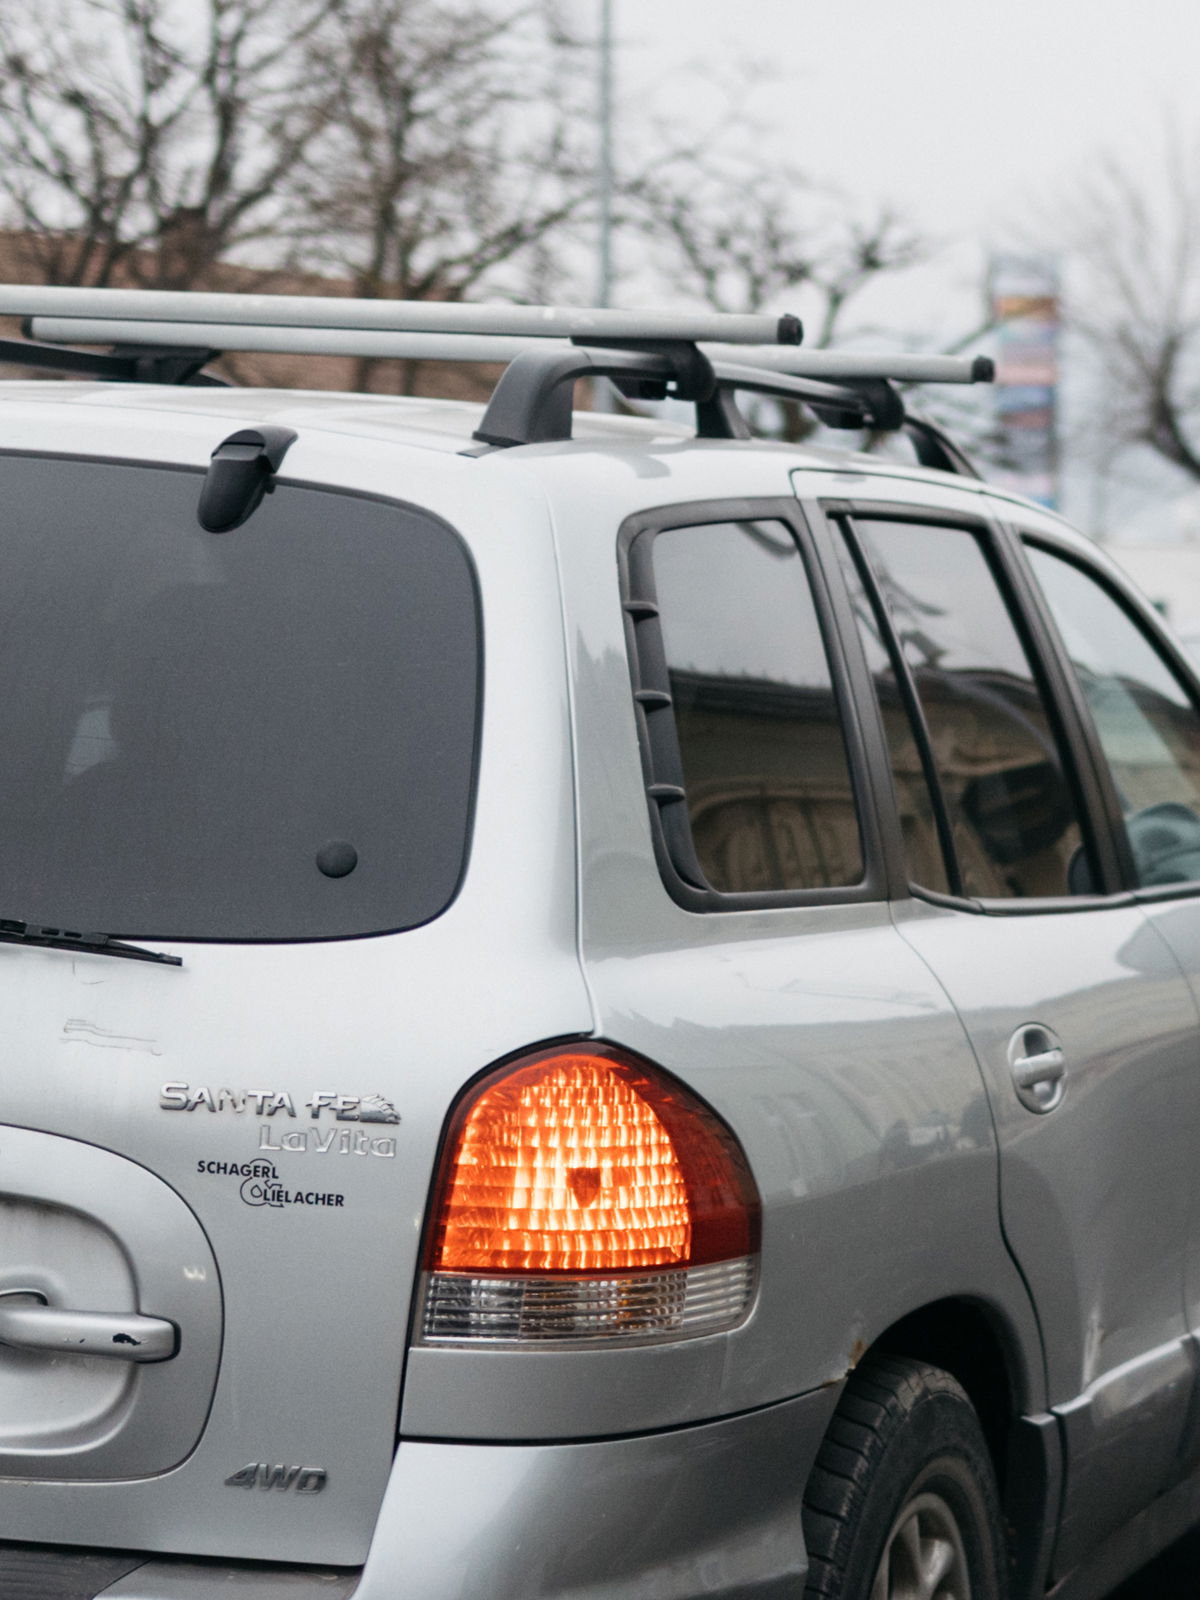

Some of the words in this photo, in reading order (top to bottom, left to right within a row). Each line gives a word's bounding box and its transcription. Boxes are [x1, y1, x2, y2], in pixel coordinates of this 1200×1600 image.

[159, 1081, 297, 1118] SANTA
[306, 1090, 360, 1122] FE
[196, 1160, 280, 1180] SCHAGERL
[262, 1188, 345, 1208] LIELACHER
[223, 1462, 328, 1494] 4WD
